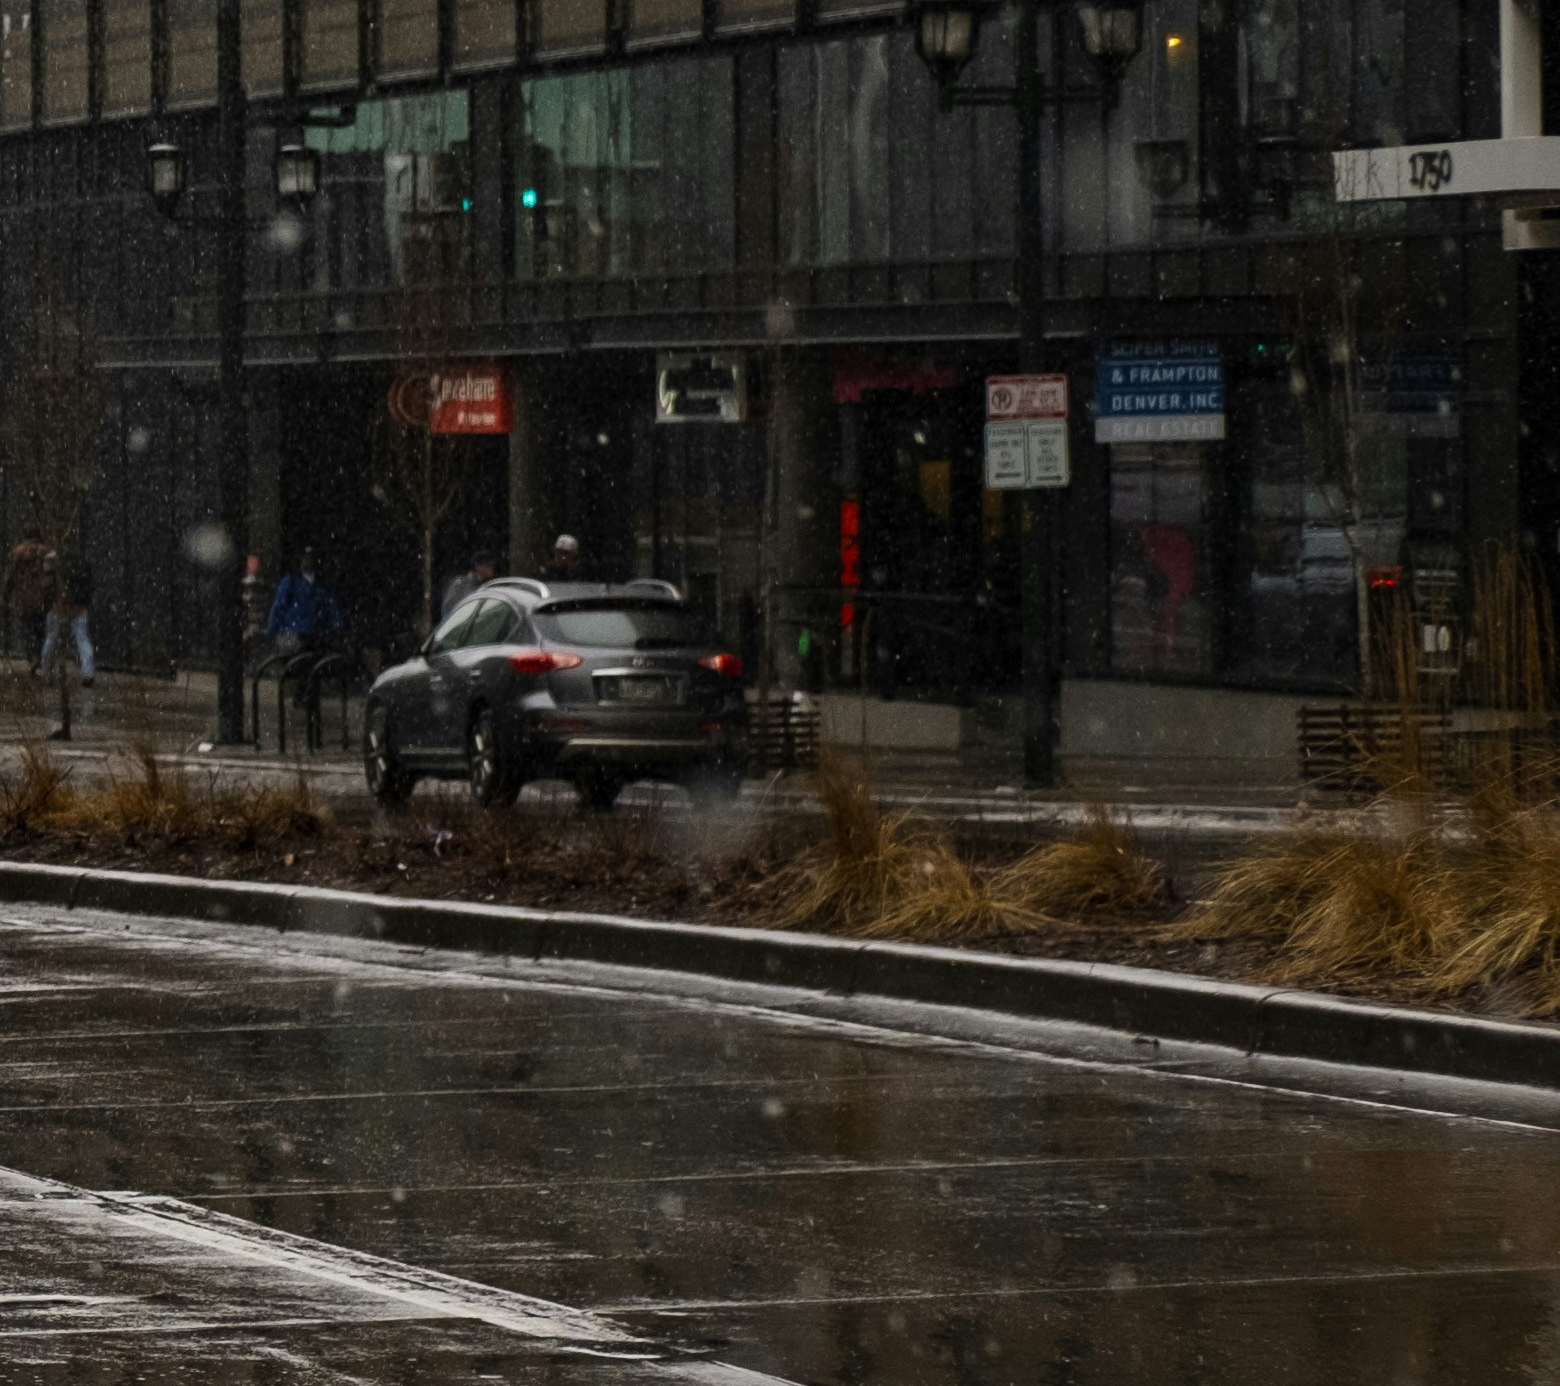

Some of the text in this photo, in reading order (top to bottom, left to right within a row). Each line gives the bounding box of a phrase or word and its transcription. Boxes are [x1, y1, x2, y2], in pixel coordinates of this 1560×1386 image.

[1408, 149, 1452, 192] 1750
[1111, 365, 1219, 384] & FRAMPTON
